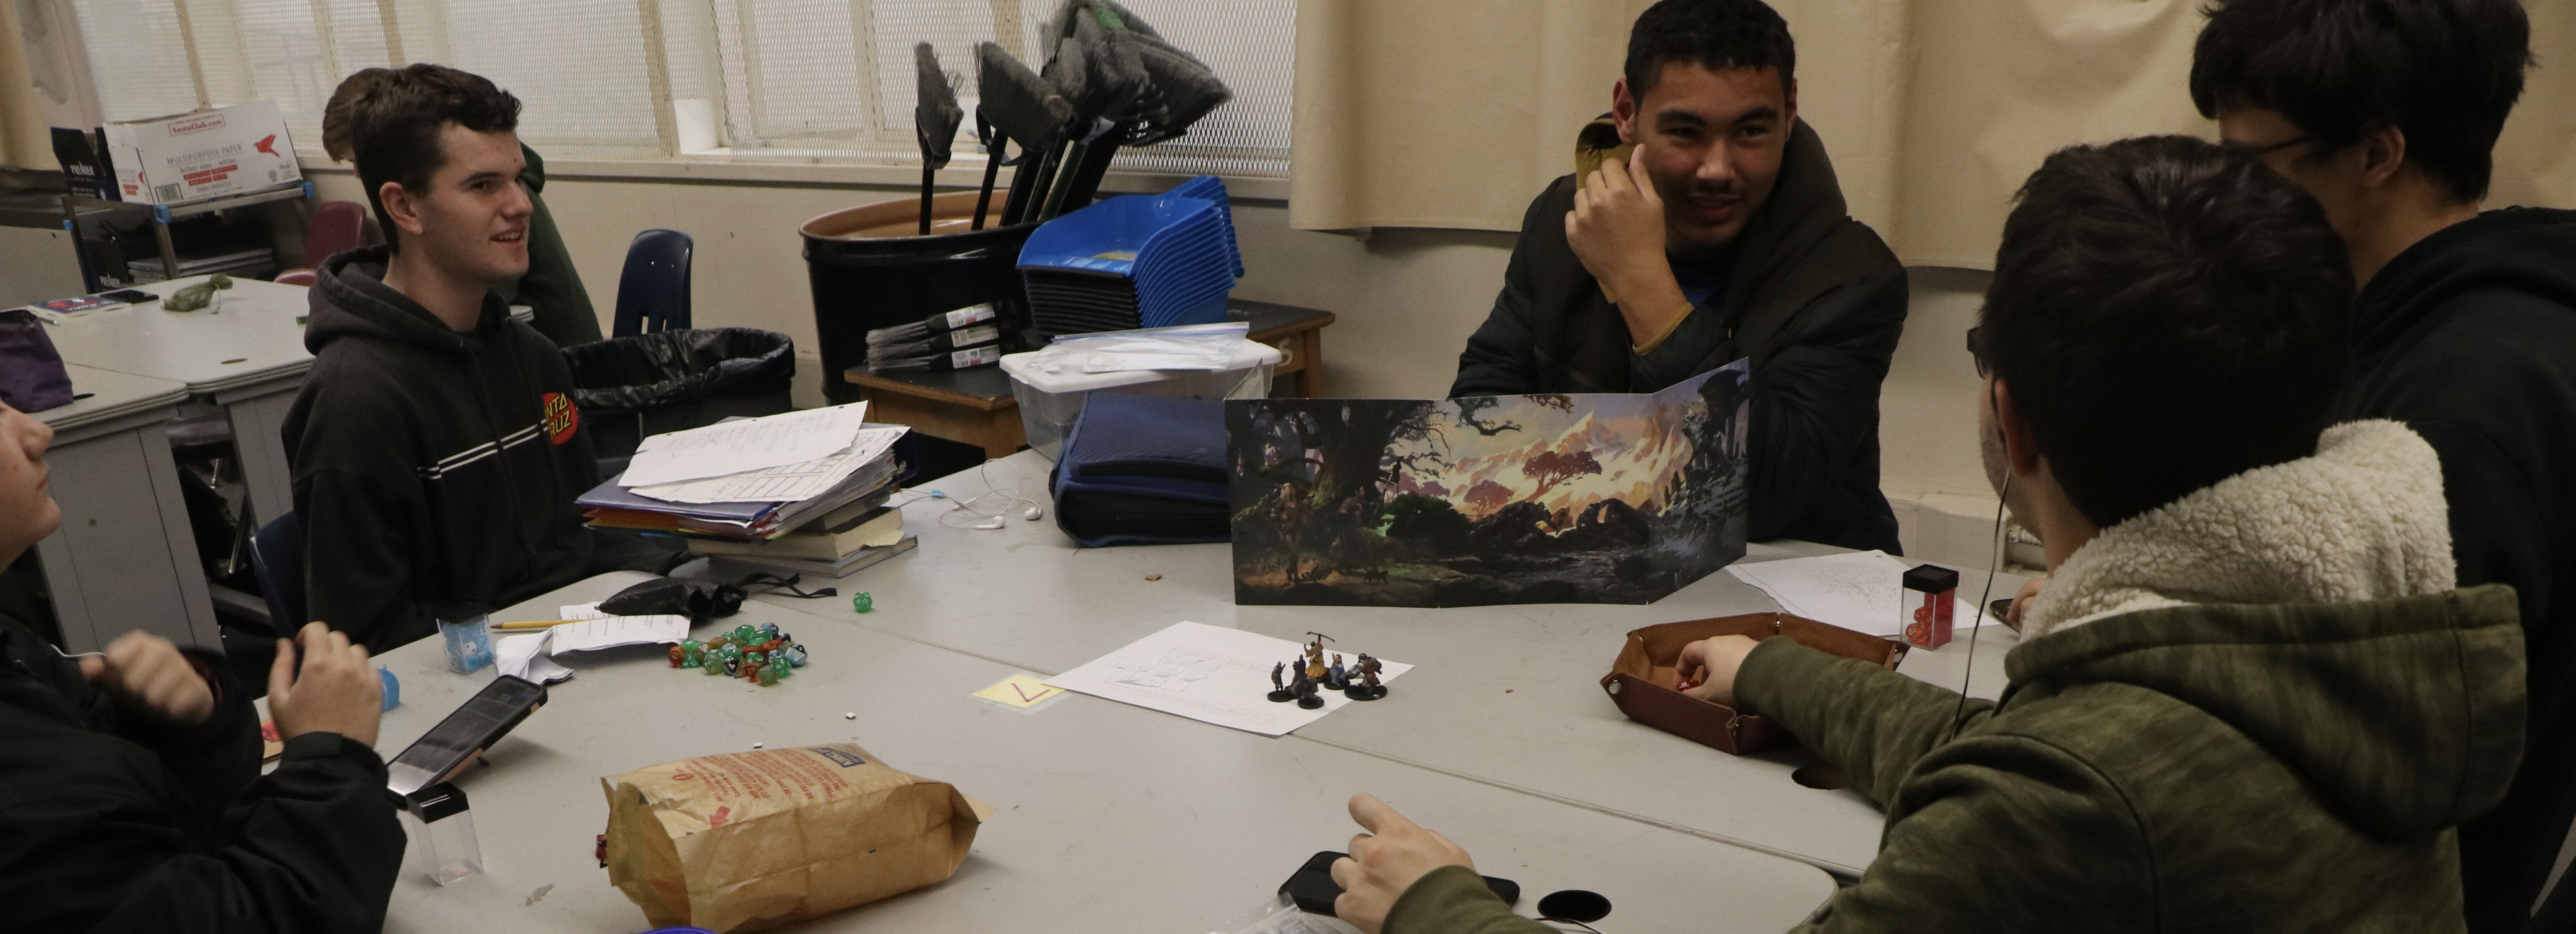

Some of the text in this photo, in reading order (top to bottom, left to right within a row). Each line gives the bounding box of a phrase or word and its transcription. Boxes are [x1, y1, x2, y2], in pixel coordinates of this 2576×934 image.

[172, 120, 222, 134] SamsClub.com
[167, 144, 242, 164] MULTIPURPOSE PAPER
[218, 158, 237, 166] white
[544, 392, 568, 423] NTA
[549, 410, 571, 436] RUZ
